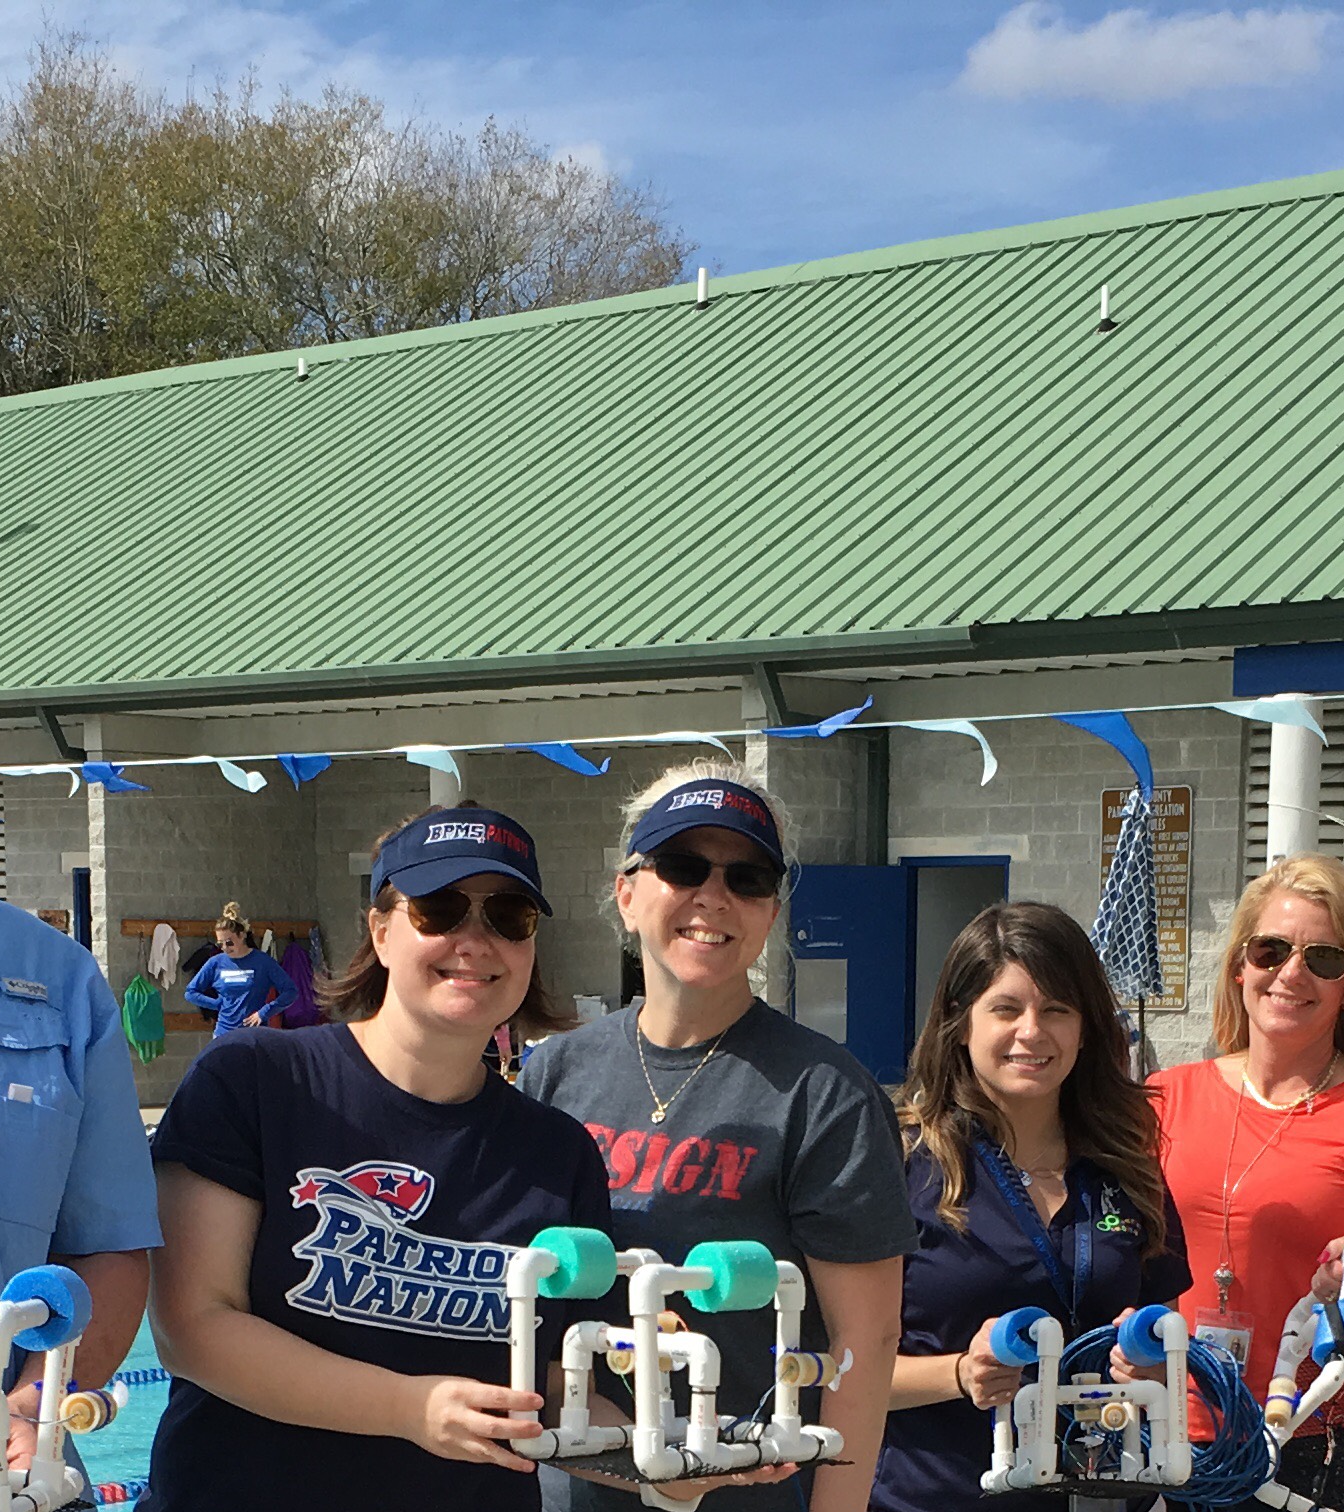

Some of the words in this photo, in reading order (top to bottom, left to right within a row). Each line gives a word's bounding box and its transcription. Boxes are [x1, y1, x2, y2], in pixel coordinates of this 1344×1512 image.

[666, 790, 724, 810] BPMS
[423, 823, 486, 845] BPMS
[308, 1205, 518, 1282] PATRIO
[300, 1253, 514, 1331] NATION
